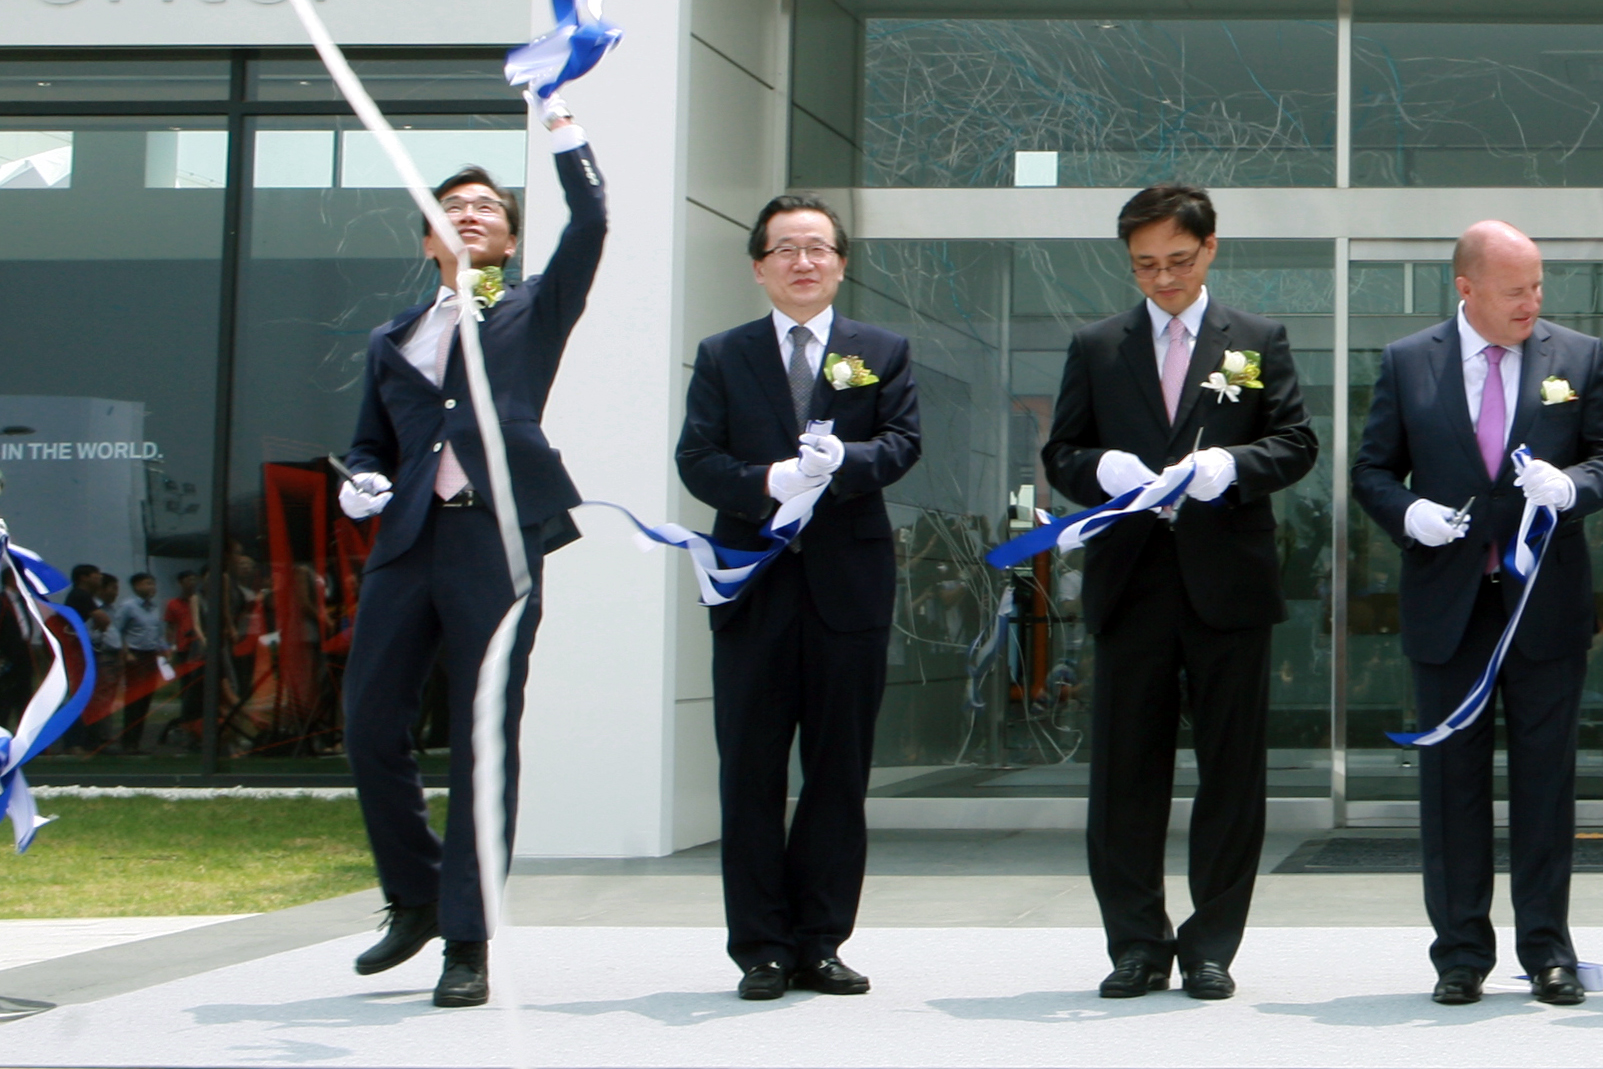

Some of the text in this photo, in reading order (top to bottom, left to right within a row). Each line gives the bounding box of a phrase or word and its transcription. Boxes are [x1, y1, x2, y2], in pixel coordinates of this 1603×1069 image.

[2, 441, 164, 460] IN THE WORLD.
